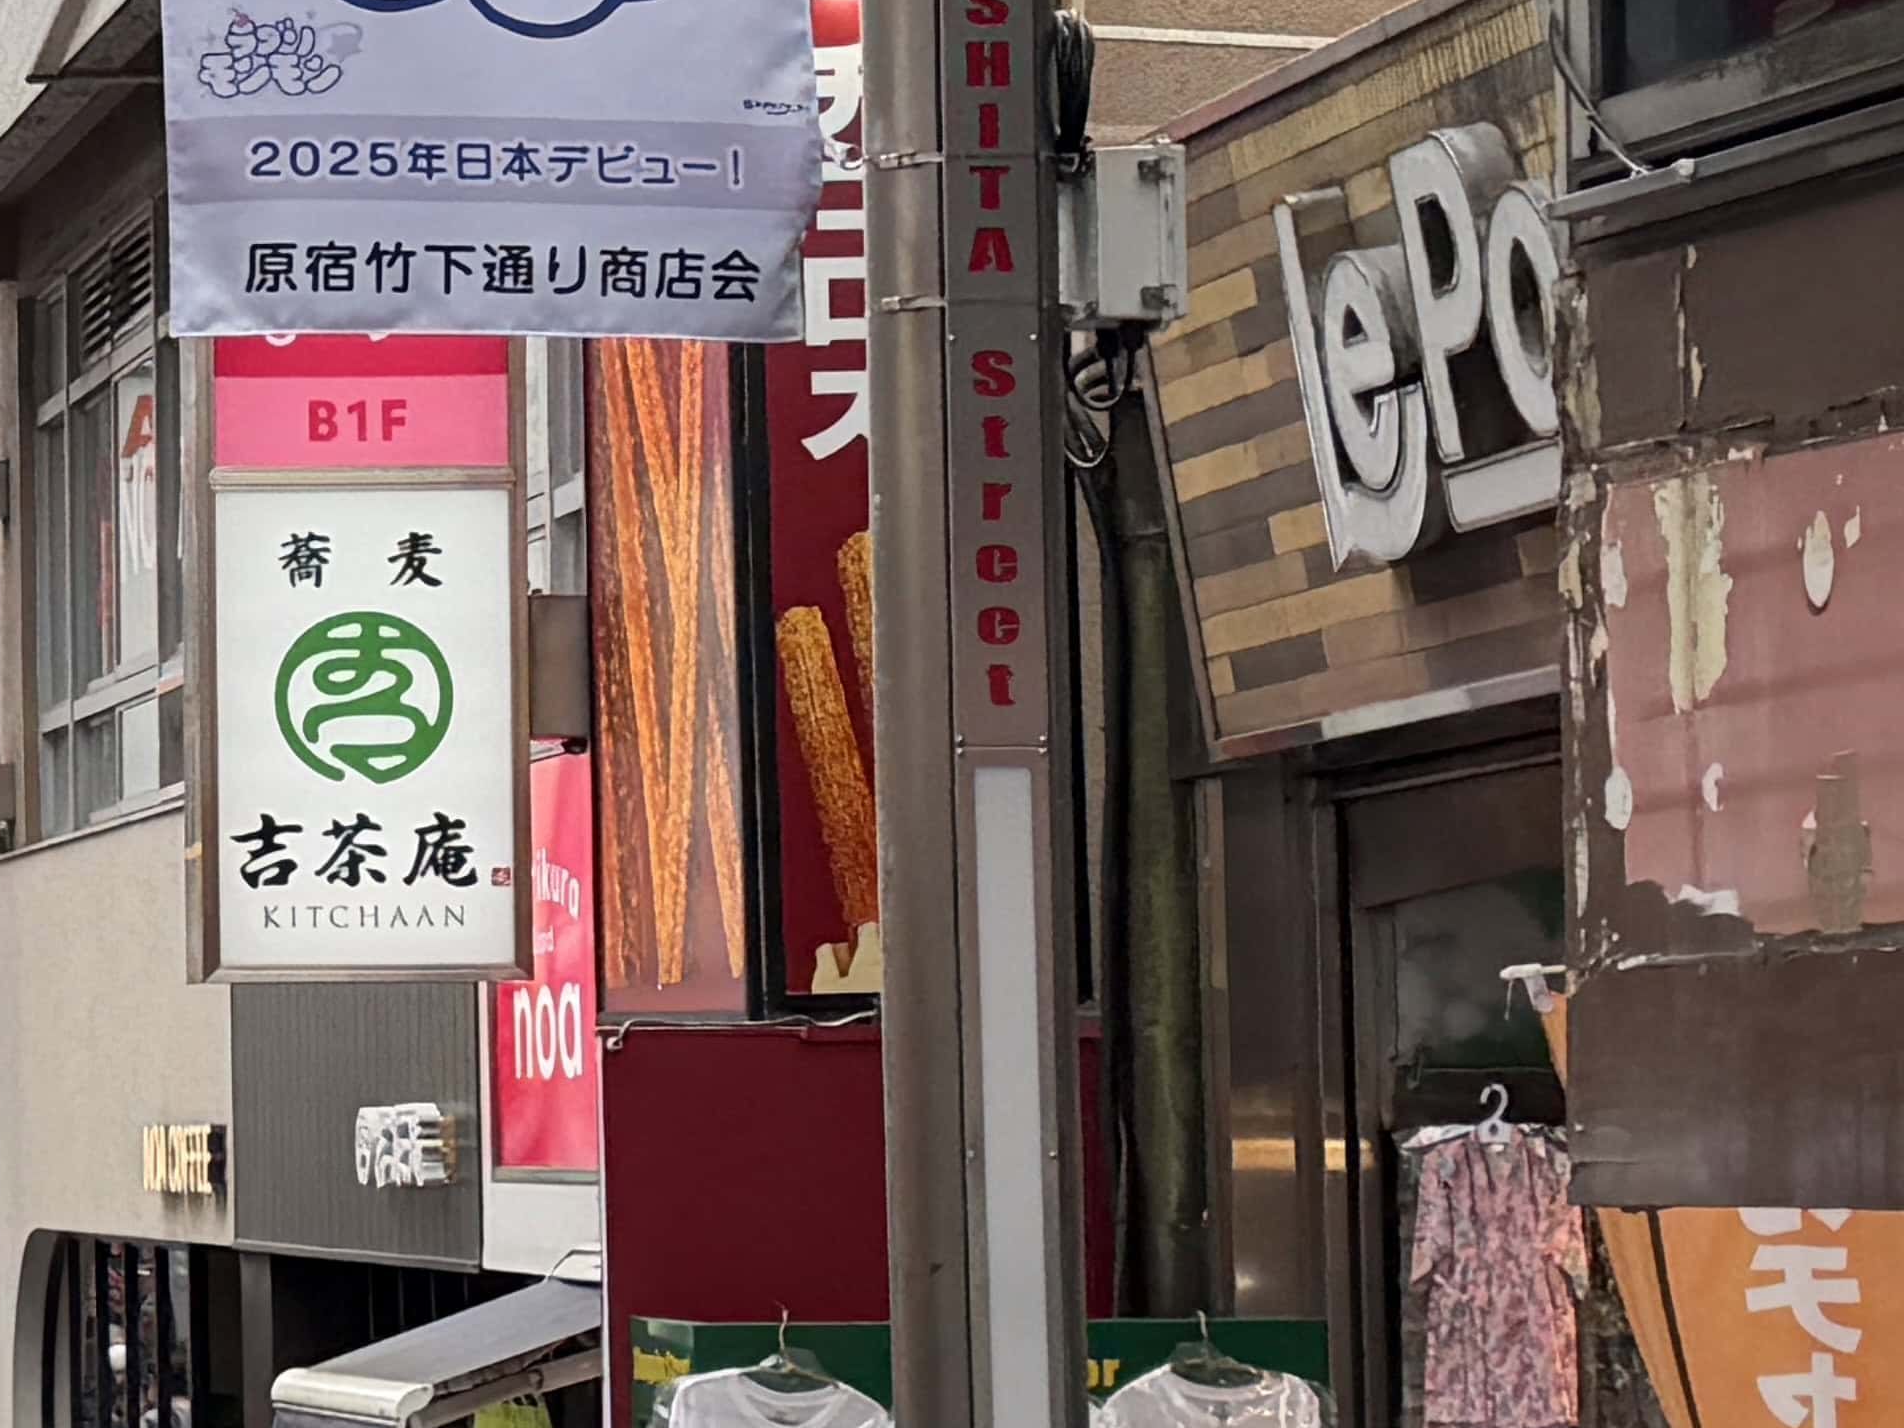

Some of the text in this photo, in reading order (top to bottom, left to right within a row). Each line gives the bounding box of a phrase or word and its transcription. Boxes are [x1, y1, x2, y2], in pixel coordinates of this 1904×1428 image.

[245, 241, 761, 303] 原宿竹下通り商店会
[307, 398, 408, 442] B1F
[971, 349, 1019, 708] Street
[230, 811, 479, 889] 吉茶庵
[264, 905, 464, 930] KITCHAAN
[513, 981, 582, 1080] noa
